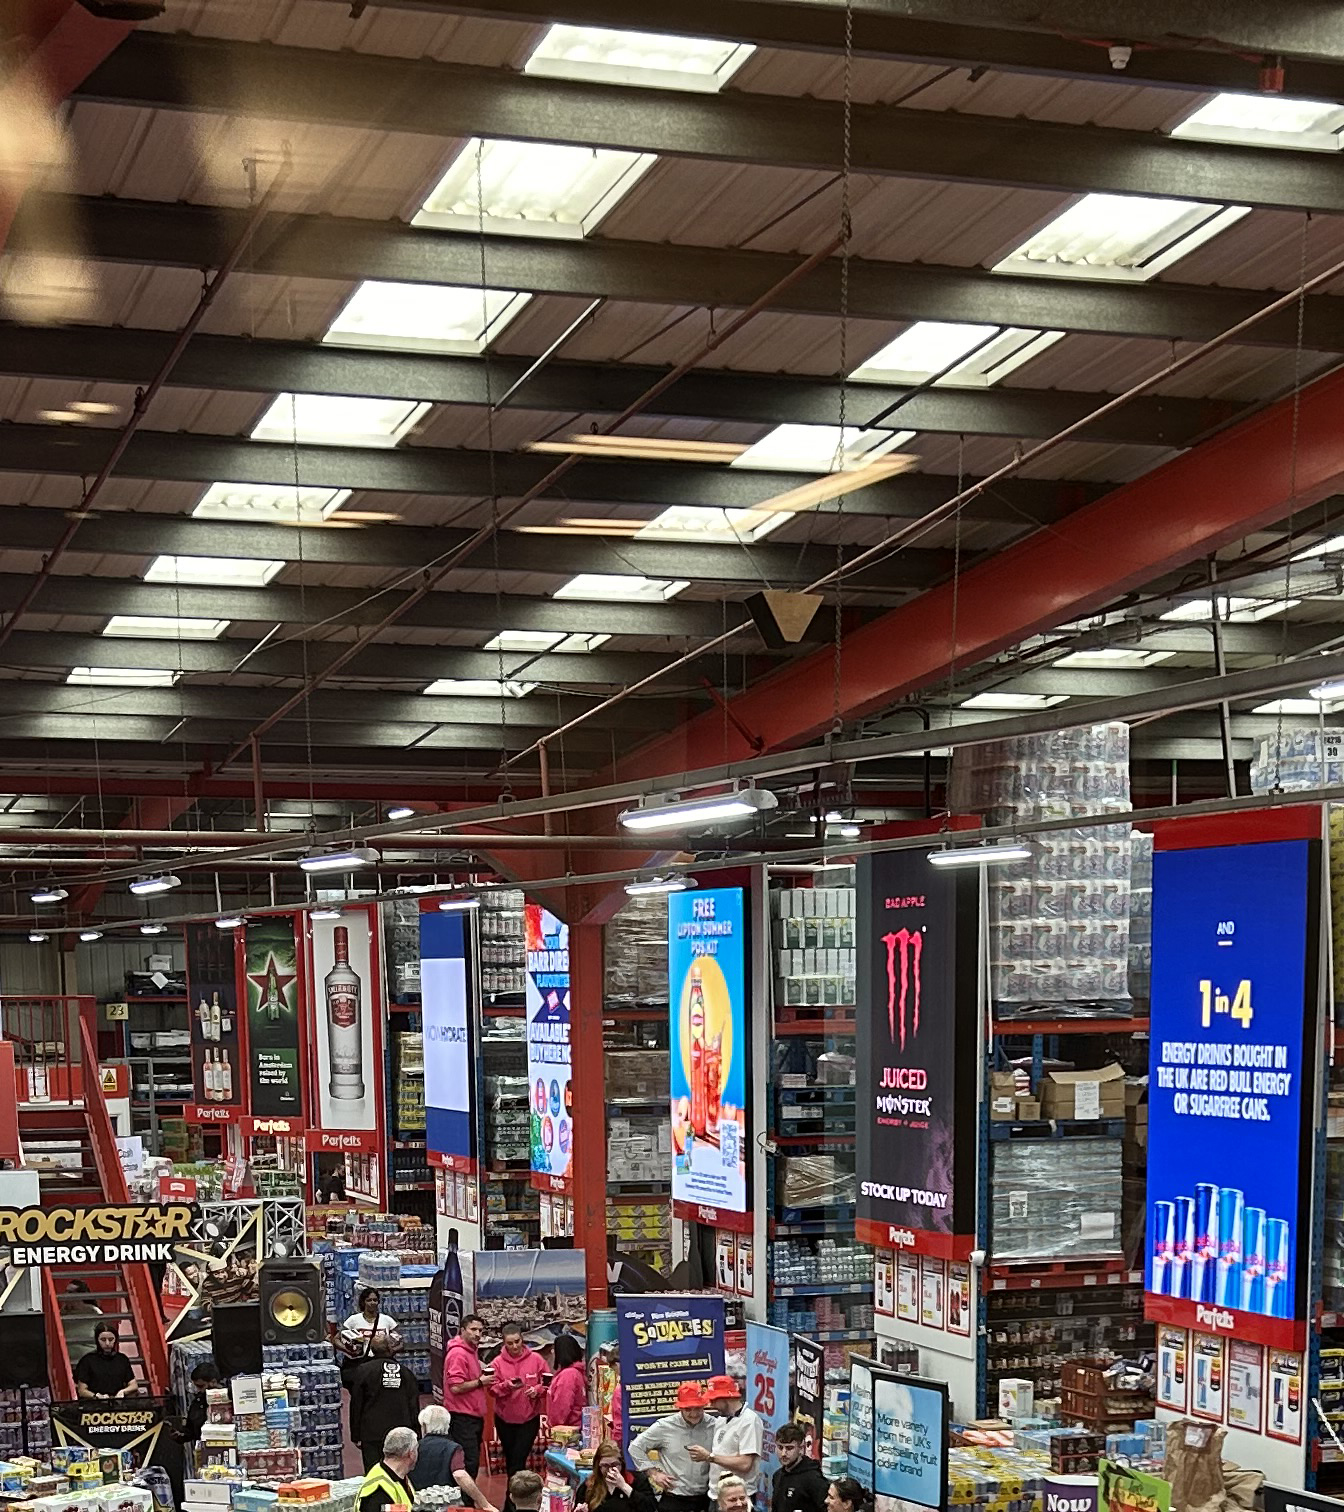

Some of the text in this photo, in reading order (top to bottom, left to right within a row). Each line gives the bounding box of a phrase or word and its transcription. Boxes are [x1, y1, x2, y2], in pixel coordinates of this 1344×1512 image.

[693, 897, 715, 918] FREE
[1216, 921, 1235, 935] AND
[1199, 980, 1254, 1029] 1 in 4
[1162, 1042, 1287, 1068] ENERGY DRINKS BOUGHT IN
[880, 1068, 927, 1090] JUICED
[1174, 1095, 1188, 1114] OR
[1190, 1096, 1240, 1119] SUGARFREE
[861, 1182, 948, 1208] STOCK UP TODAY
[13, 1244, 173, 1264] ENERGY DRINK
[754, 1374, 776, 1417] 25
[81, 1411, 154, 1426] ROCKSTAR
[901, 1420, 928, 1436] variety
[900, 1464, 922, 1477] brand
[1047, 1494, 1091, 1512] Now
